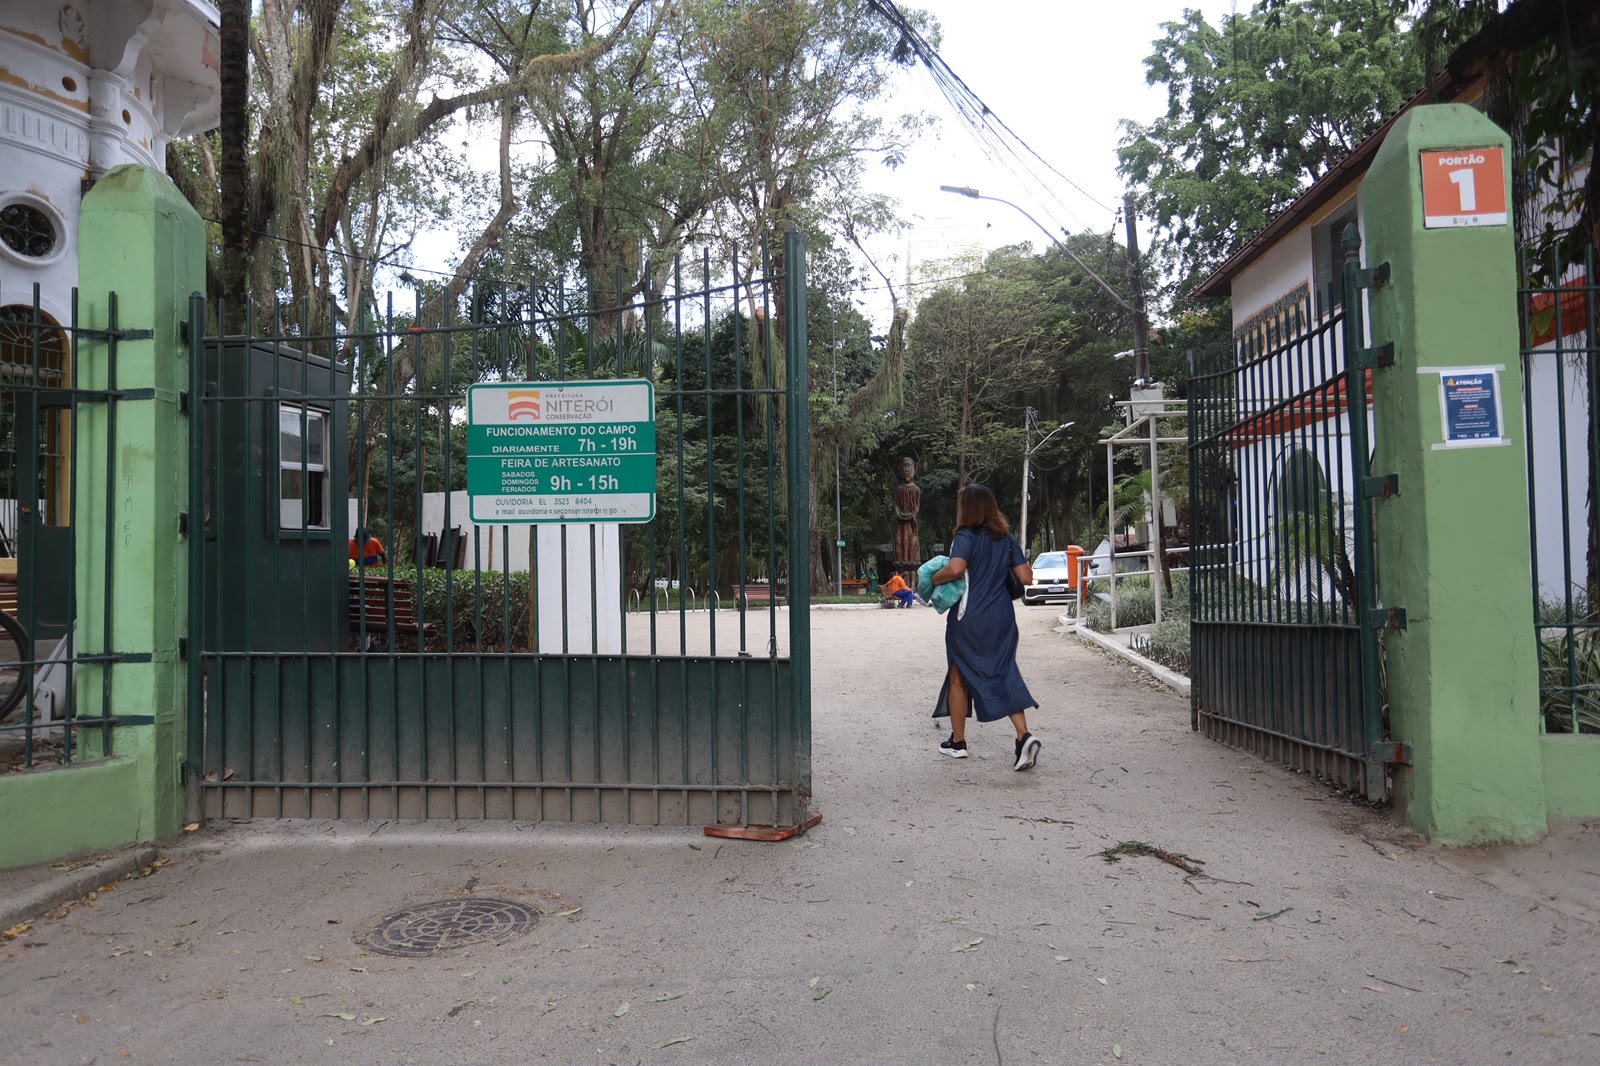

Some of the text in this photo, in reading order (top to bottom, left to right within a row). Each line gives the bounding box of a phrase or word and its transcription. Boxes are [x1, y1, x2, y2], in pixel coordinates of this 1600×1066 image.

[1438, 154, 1485, 166] PORTÃO
[1448, 167, 1477, 212] 1
[1455, 378, 1483, 386] ATENÇÃO
[546, 395, 613, 413] NITERÓI
[546, 413, 592, 421] CONSERVAÇÃO
[486, 425, 637, 437] FUNCIONAMENTO DO CAMPO
[492, 445, 560, 453] DIARIAMENTE
[578, 438, 596, 452] 7h
[610, 437, 637, 451] 19h
[501, 457, 621, 469] FEIRA DE ARTESANATO
[550, 475, 571, 491] 9h
[588, 474, 619, 491] 15h
[495, 498, 533, 506] OUVIDORIA
[518, 507, 548, 515] ouvidoria
